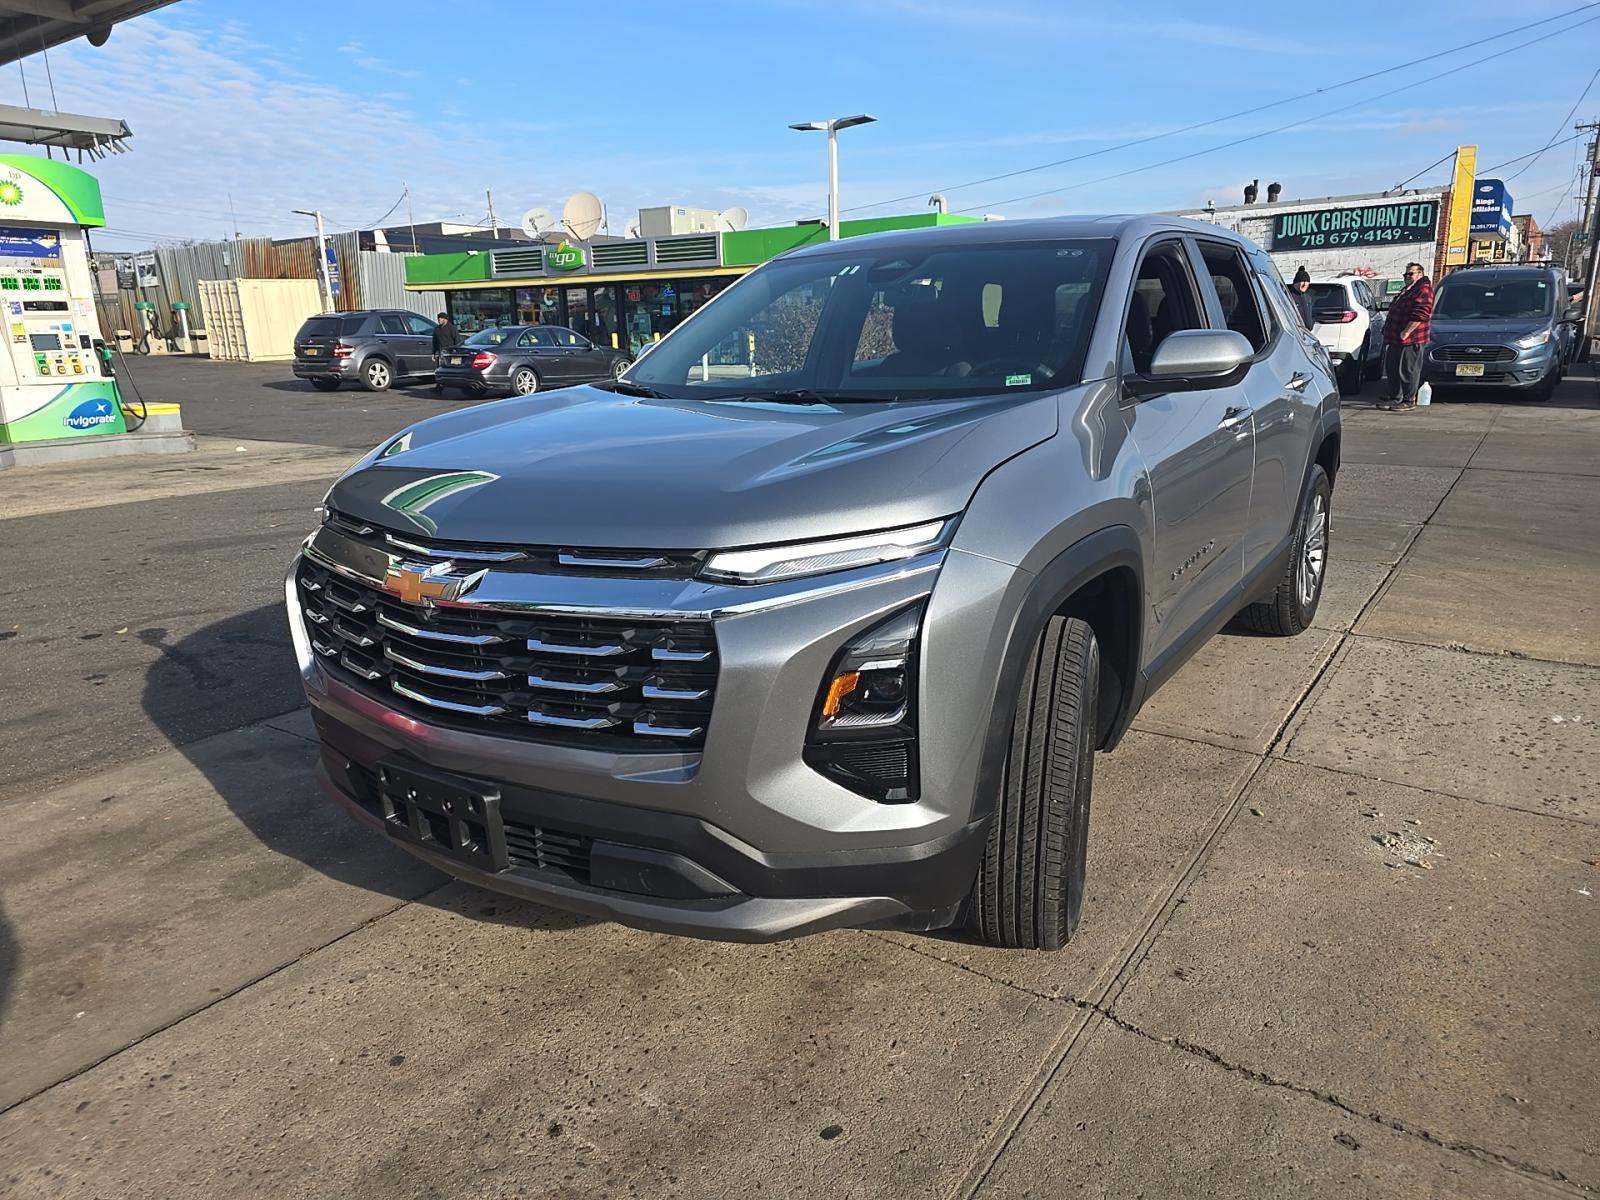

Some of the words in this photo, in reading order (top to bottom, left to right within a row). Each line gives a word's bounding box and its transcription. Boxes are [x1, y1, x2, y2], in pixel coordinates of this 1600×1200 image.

[1278, 213, 1320, 239] JUNK
[1363, 203, 1433, 228] WANTED
[1302, 233, 1325, 247] 718
[555, 252, 576, 266] go
